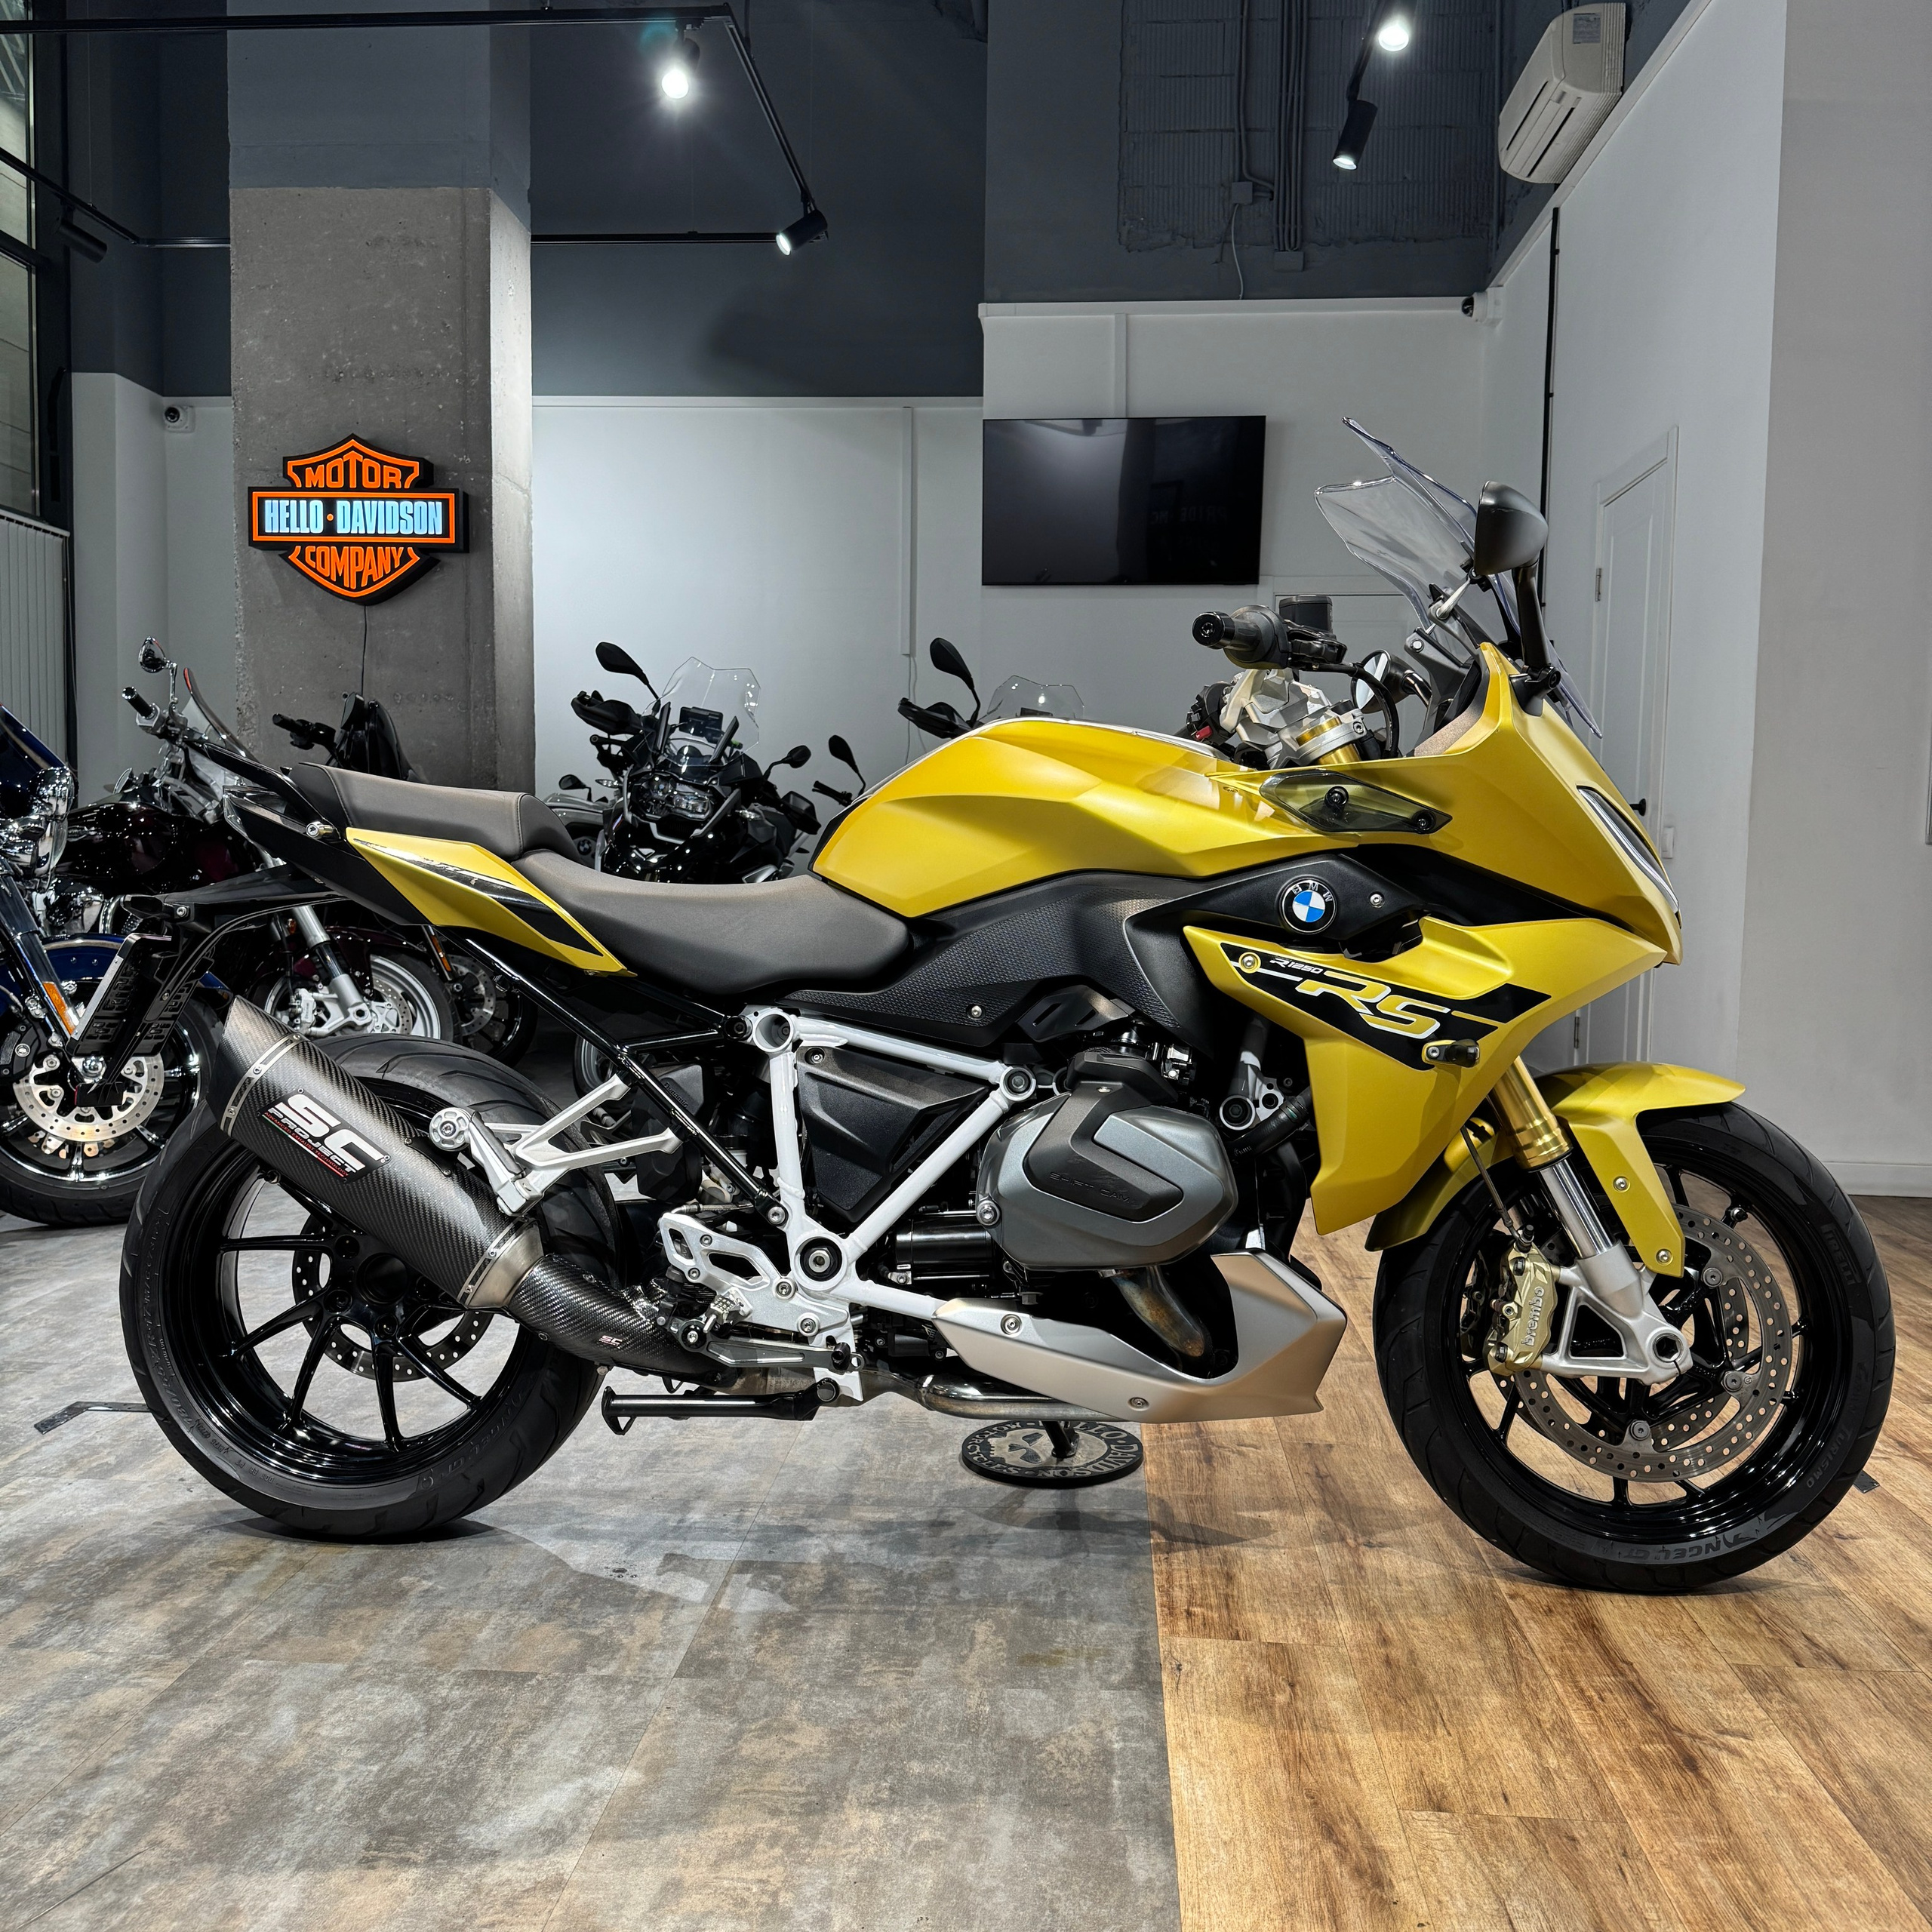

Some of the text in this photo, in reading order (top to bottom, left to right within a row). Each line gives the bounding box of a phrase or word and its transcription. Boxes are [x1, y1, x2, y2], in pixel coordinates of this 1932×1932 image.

[305, 451, 401, 488] MOTOR
[264, 500, 442, 535] HELLO DAVIDSON
[305, 546, 404, 589] COMPANY
[1291, 881, 1333, 903] BMW
[1296, 971, 1451, 1039] RS
[263, 1111, 349, 1177] ADVANCED EXHAUST TECHNOLOGY
[267, 1106, 356, 1174] PROJECT
[275, 1094, 385, 1171] SC
[1521, 1286, 1546, 1347] brembo
